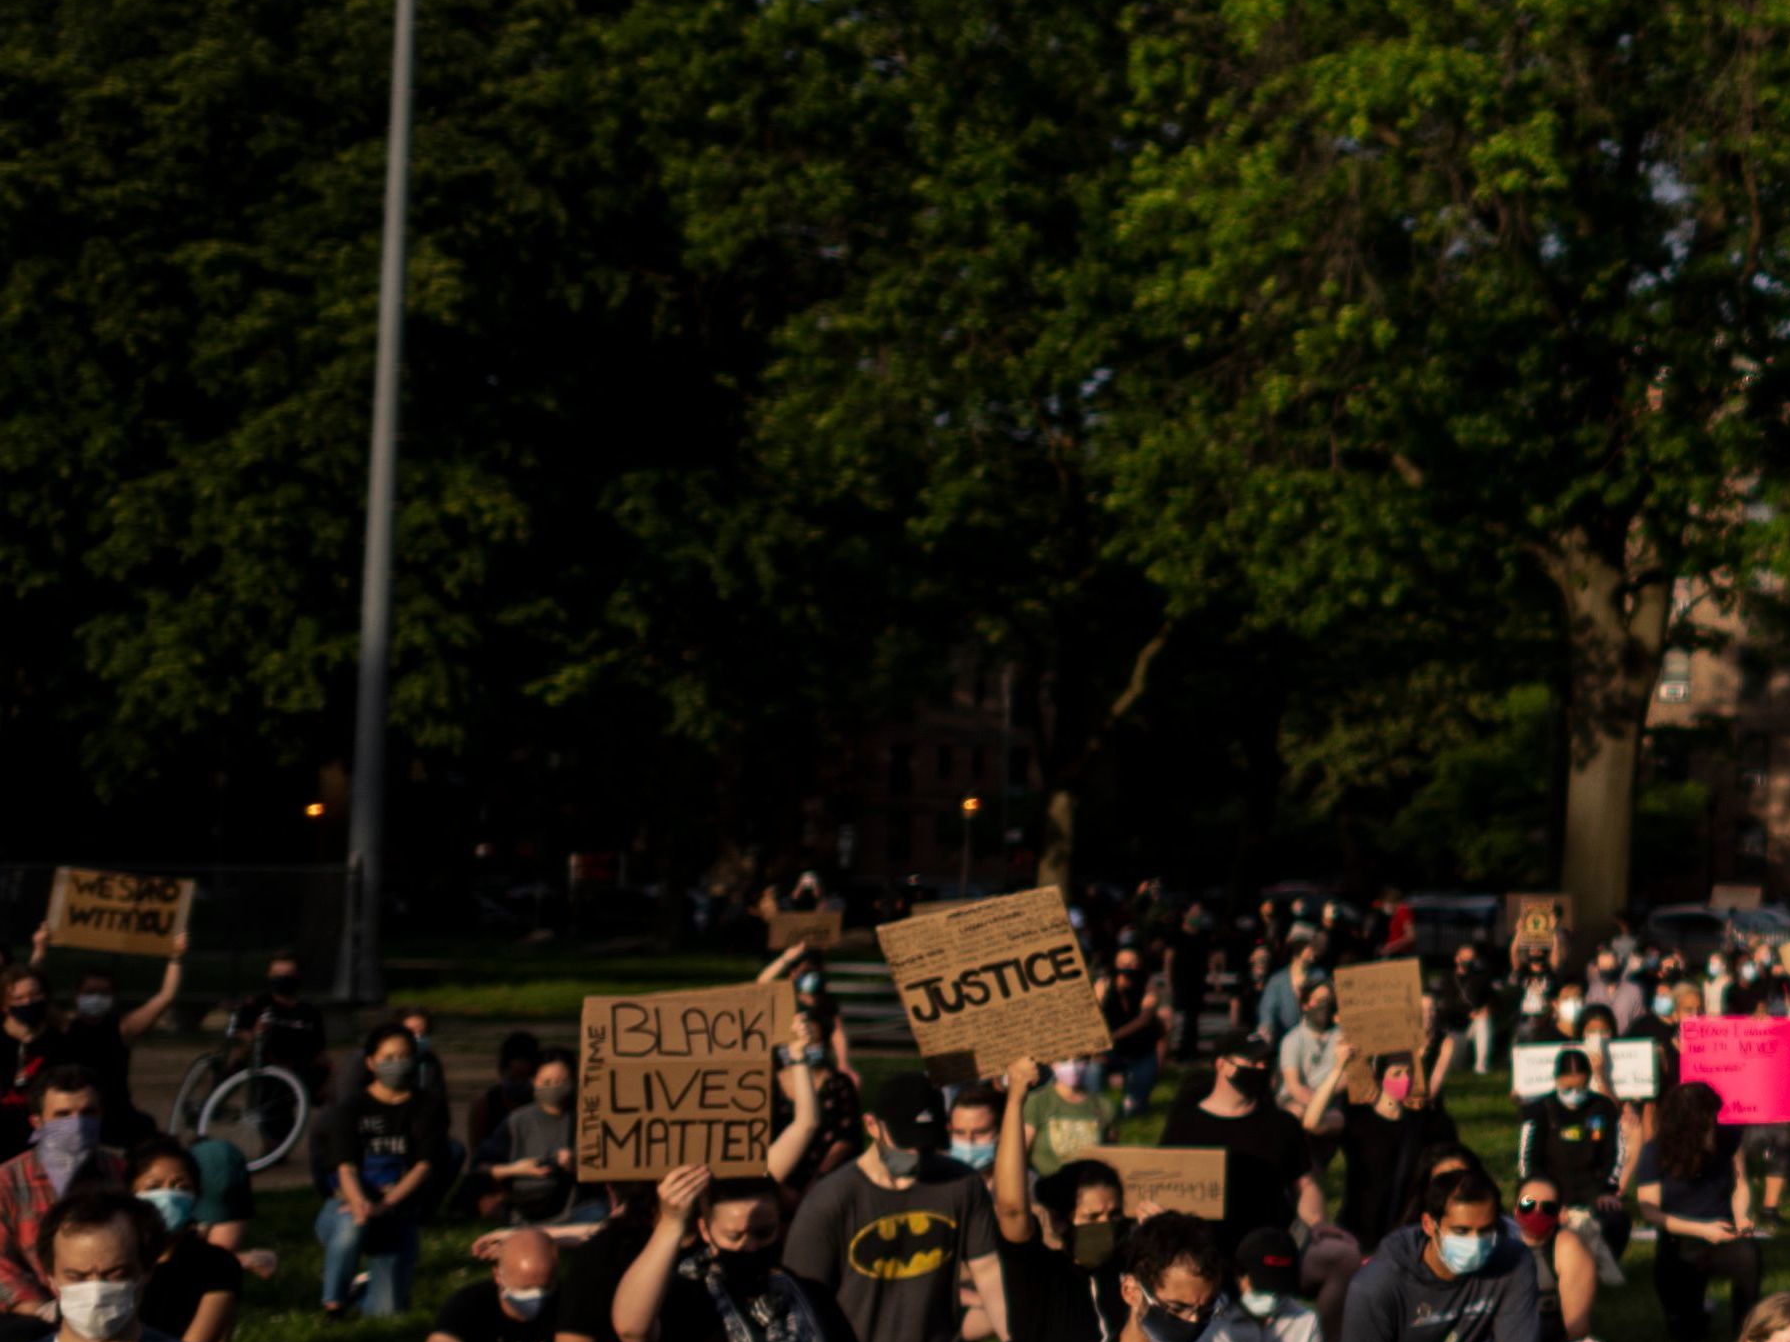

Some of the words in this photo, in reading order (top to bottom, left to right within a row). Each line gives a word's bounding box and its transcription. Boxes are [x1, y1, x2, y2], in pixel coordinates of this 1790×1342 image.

[905, 944, 1081, 1023] JUSTICE
[611, 1001, 768, 1057] BLACK
[584, 1024, 606, 1088] TIME
[582, 1095, 600, 1133] THE
[609, 1069, 768, 1113] LIVES
[581, 1133, 602, 1170] ALL
[601, 1117, 769, 1168] MATTER
